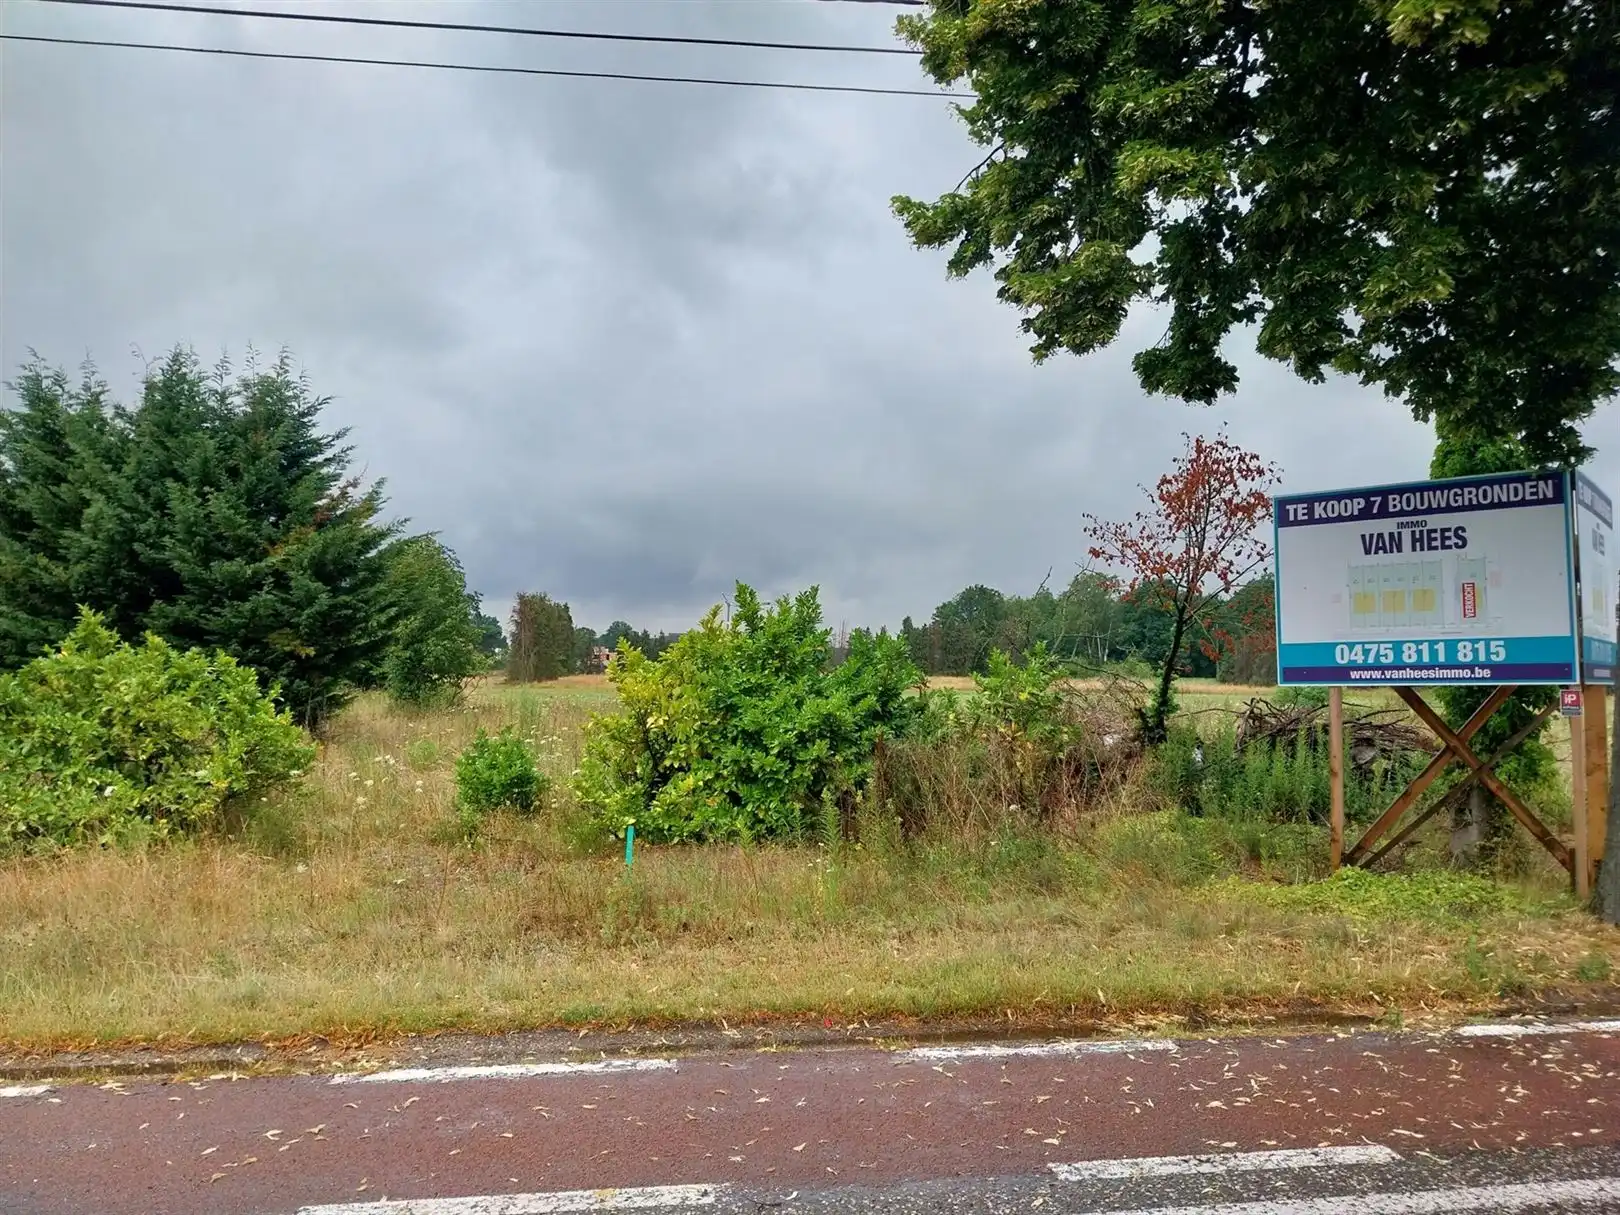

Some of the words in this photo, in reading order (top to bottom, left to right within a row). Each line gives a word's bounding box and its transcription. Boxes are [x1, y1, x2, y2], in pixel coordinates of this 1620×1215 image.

[1286, 503, 1308, 521] TE
[1314, 499, 1365, 520] KOOP
[1370, 496, 1382, 514] 7
[1388, 480, 1554, 512] BOUWGRONDEN
[1396, 520, 1428, 530] IMMO
[1360, 531, 1403, 556] VAN
[1411, 526, 1468, 553] HEES
[1464, 583, 1475, 618] VERKOCHT
[1335, 643, 1394, 664] 0475
[1402, 642, 1445, 663] 811
[1457, 640, 1506, 662] 815
[1350, 666, 1491, 680] www.vanheesimmo.be
